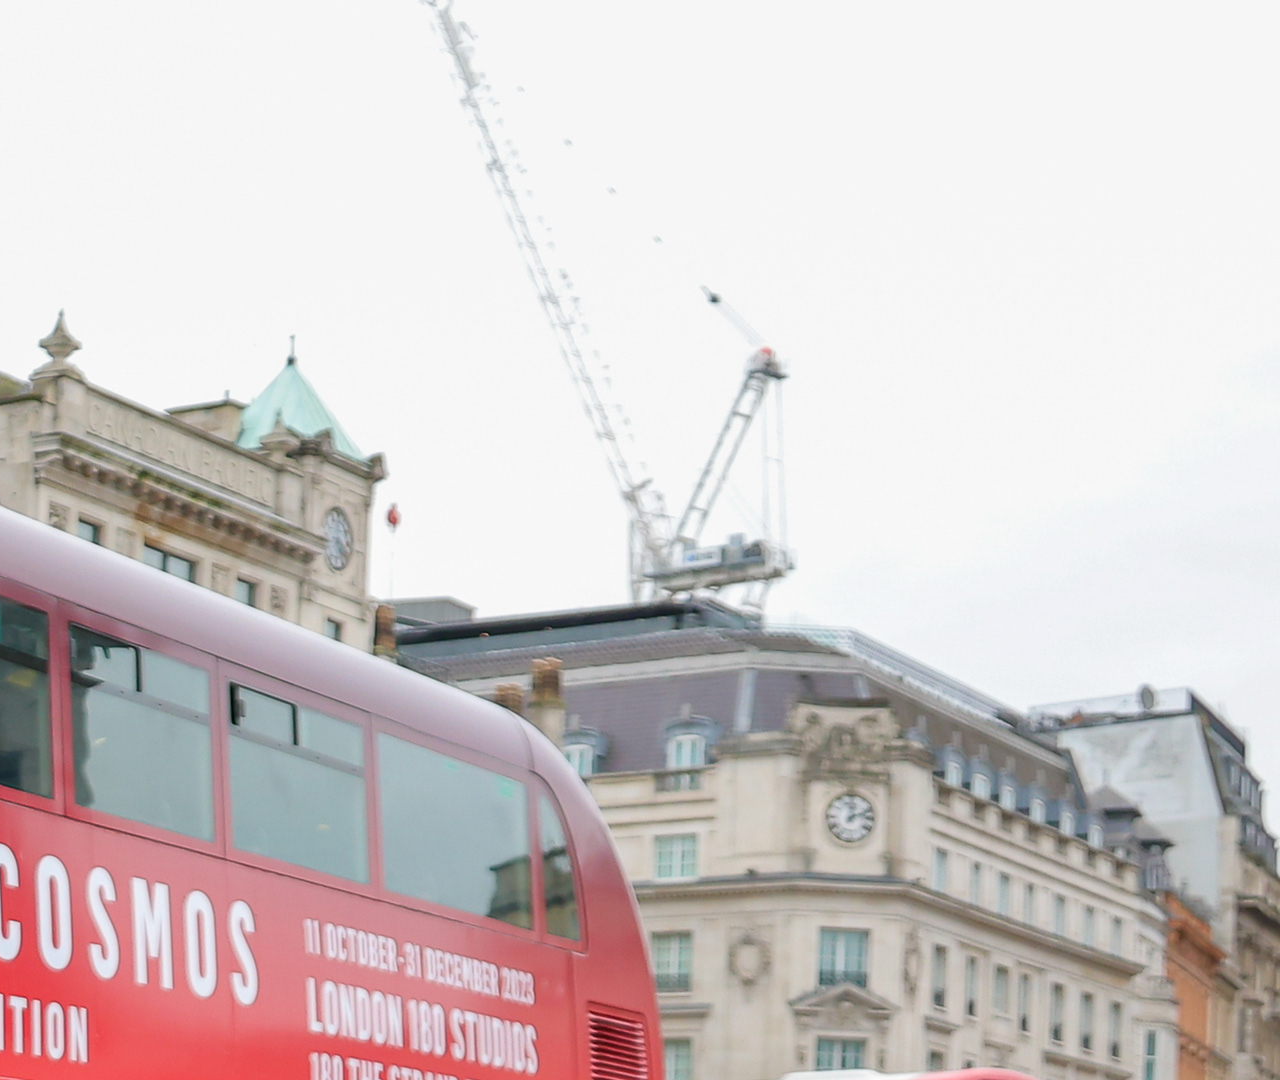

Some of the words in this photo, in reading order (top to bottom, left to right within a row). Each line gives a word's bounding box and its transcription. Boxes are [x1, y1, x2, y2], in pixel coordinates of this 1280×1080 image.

[302, 918, 321, 955] 11
[424, 946, 499, 997] DECEMBER
[501, 966, 535, 1005] 2023
[305, 977, 404, 1048] LONDON
[407, 998, 446, 1056] 180
[449, 1006, 538, 1075] STUDIOS
